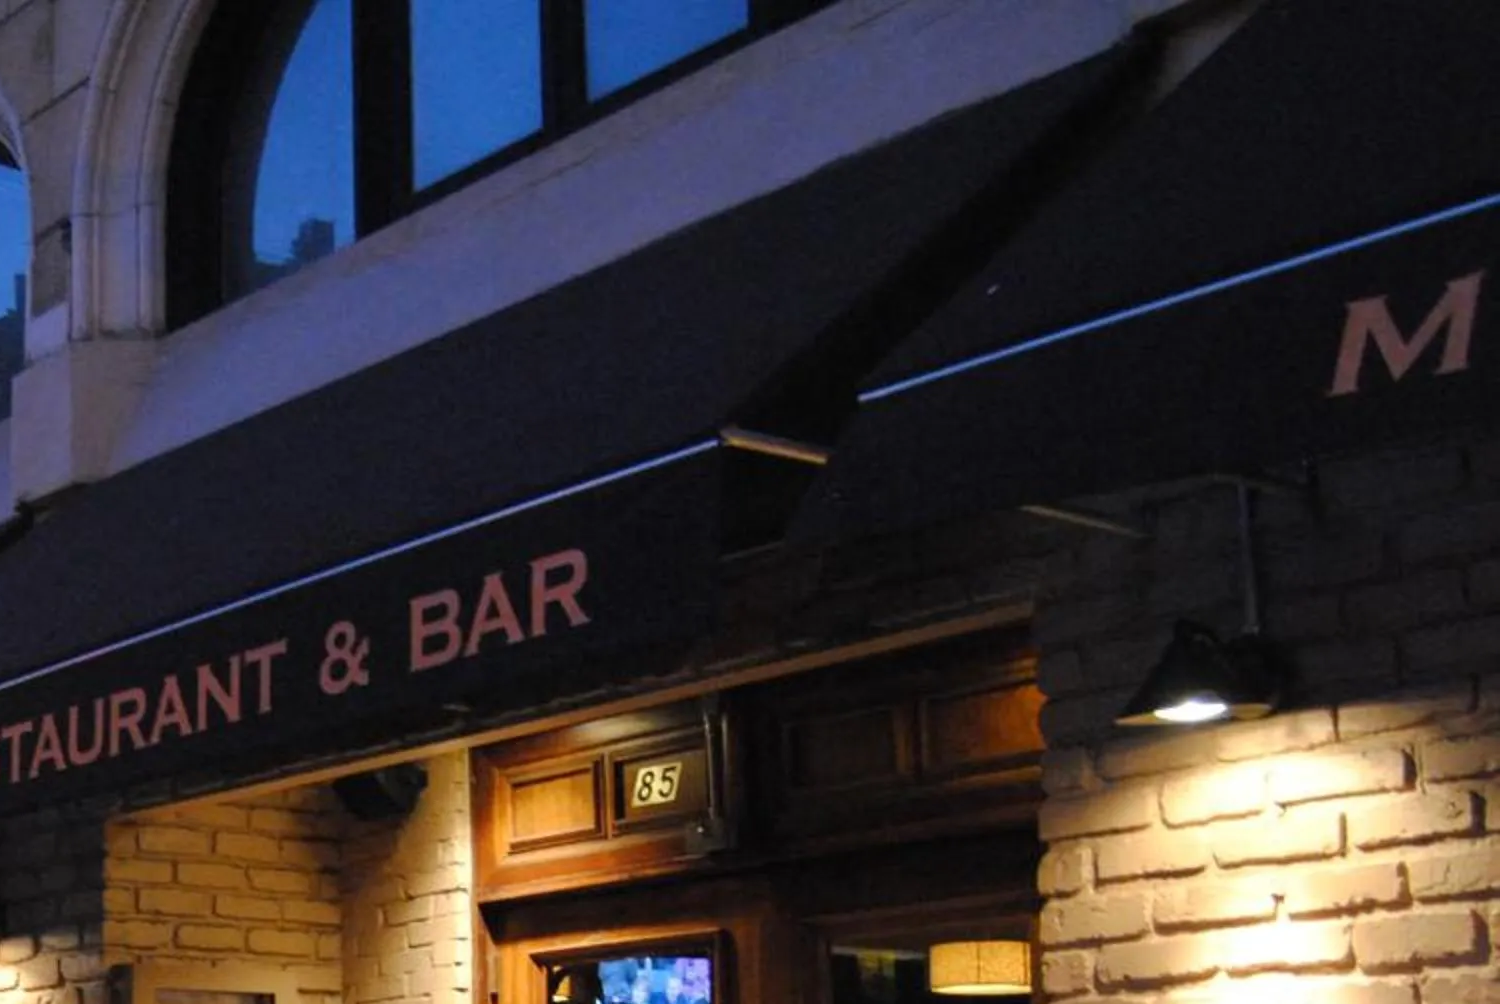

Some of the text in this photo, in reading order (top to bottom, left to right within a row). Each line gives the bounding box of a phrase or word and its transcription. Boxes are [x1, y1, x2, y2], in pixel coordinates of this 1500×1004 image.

[1327, 269, 1486, 397] M
[318, 620, 372, 697] &
[408, 547, 593, 673] BAR
[637, 766, 677, 802] 85
